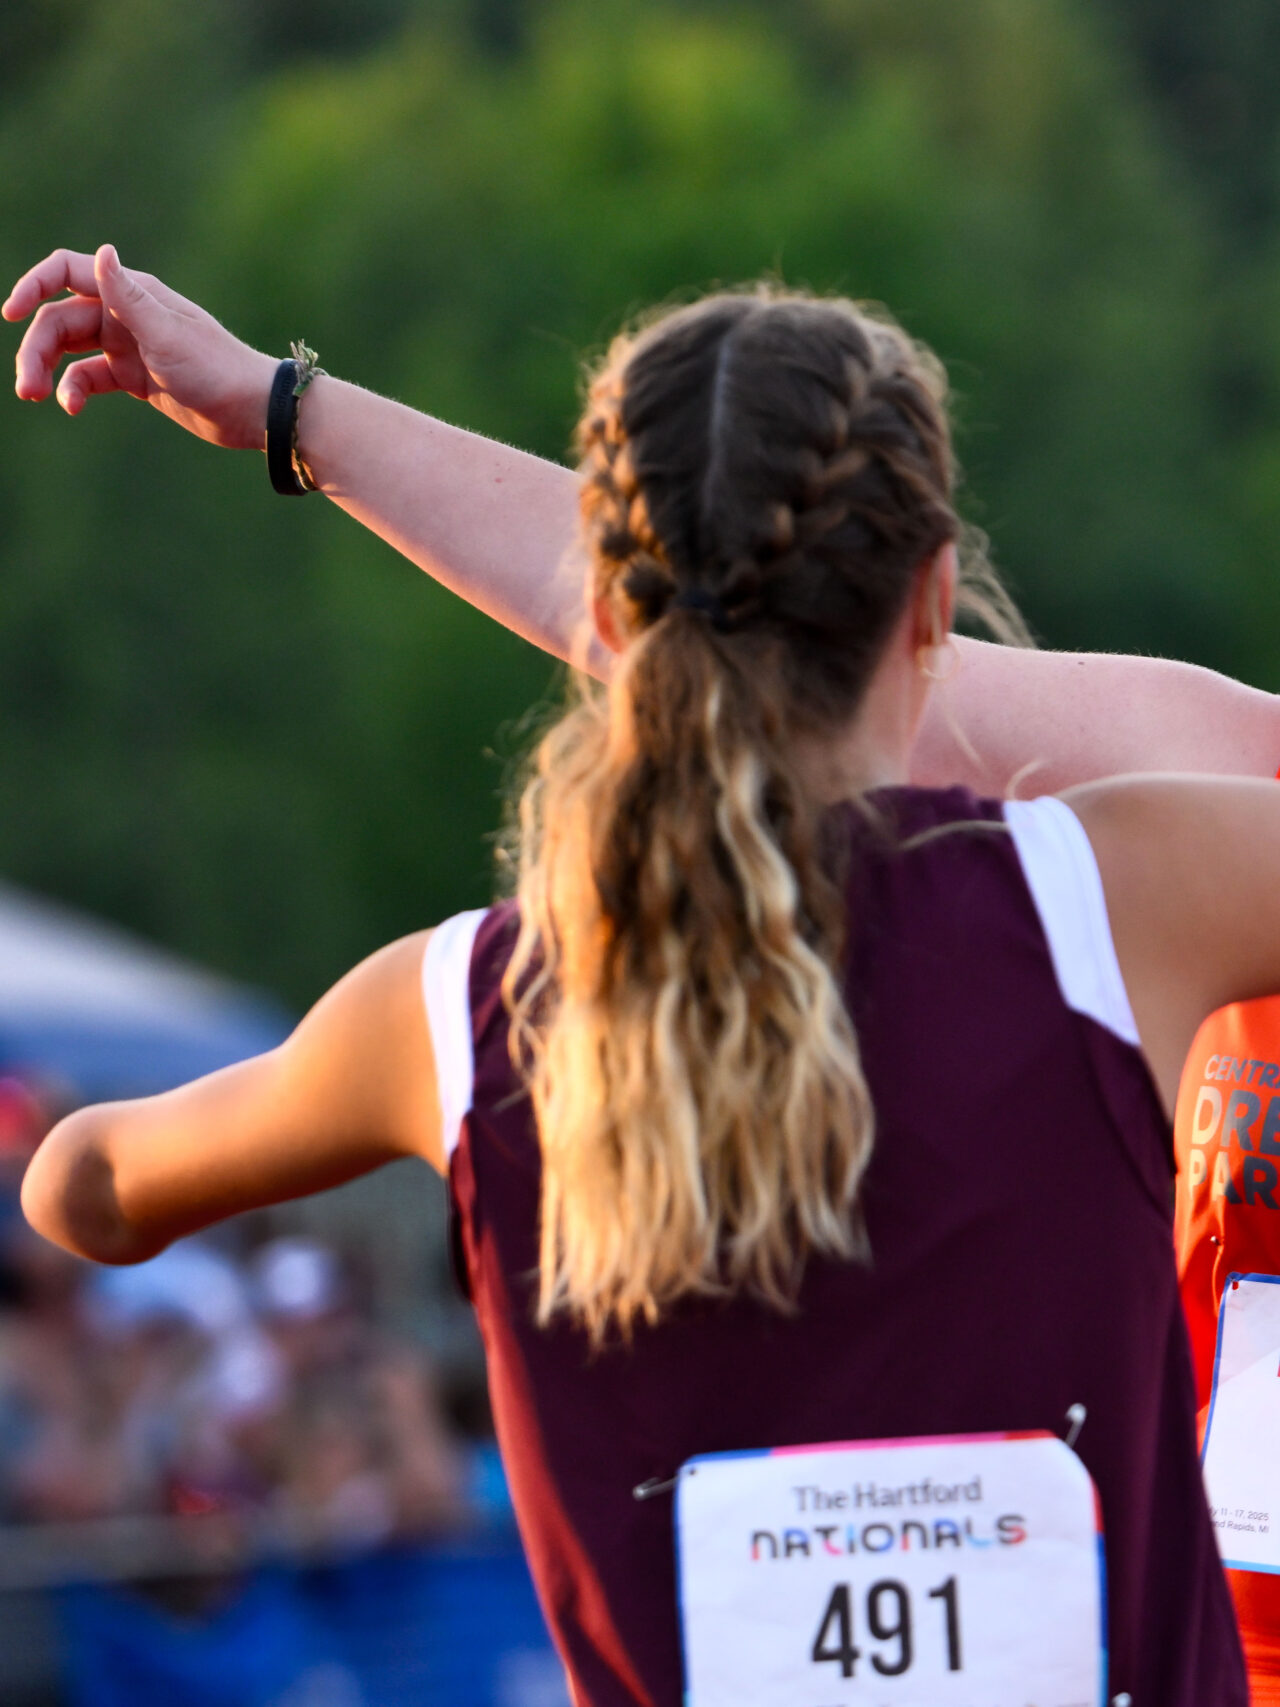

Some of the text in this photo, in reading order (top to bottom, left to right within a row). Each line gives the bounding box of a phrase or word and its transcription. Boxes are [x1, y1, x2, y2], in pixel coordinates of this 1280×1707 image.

[793, 1474, 983, 1512] The Hartford
[811, 1574, 964, 1680] 491
